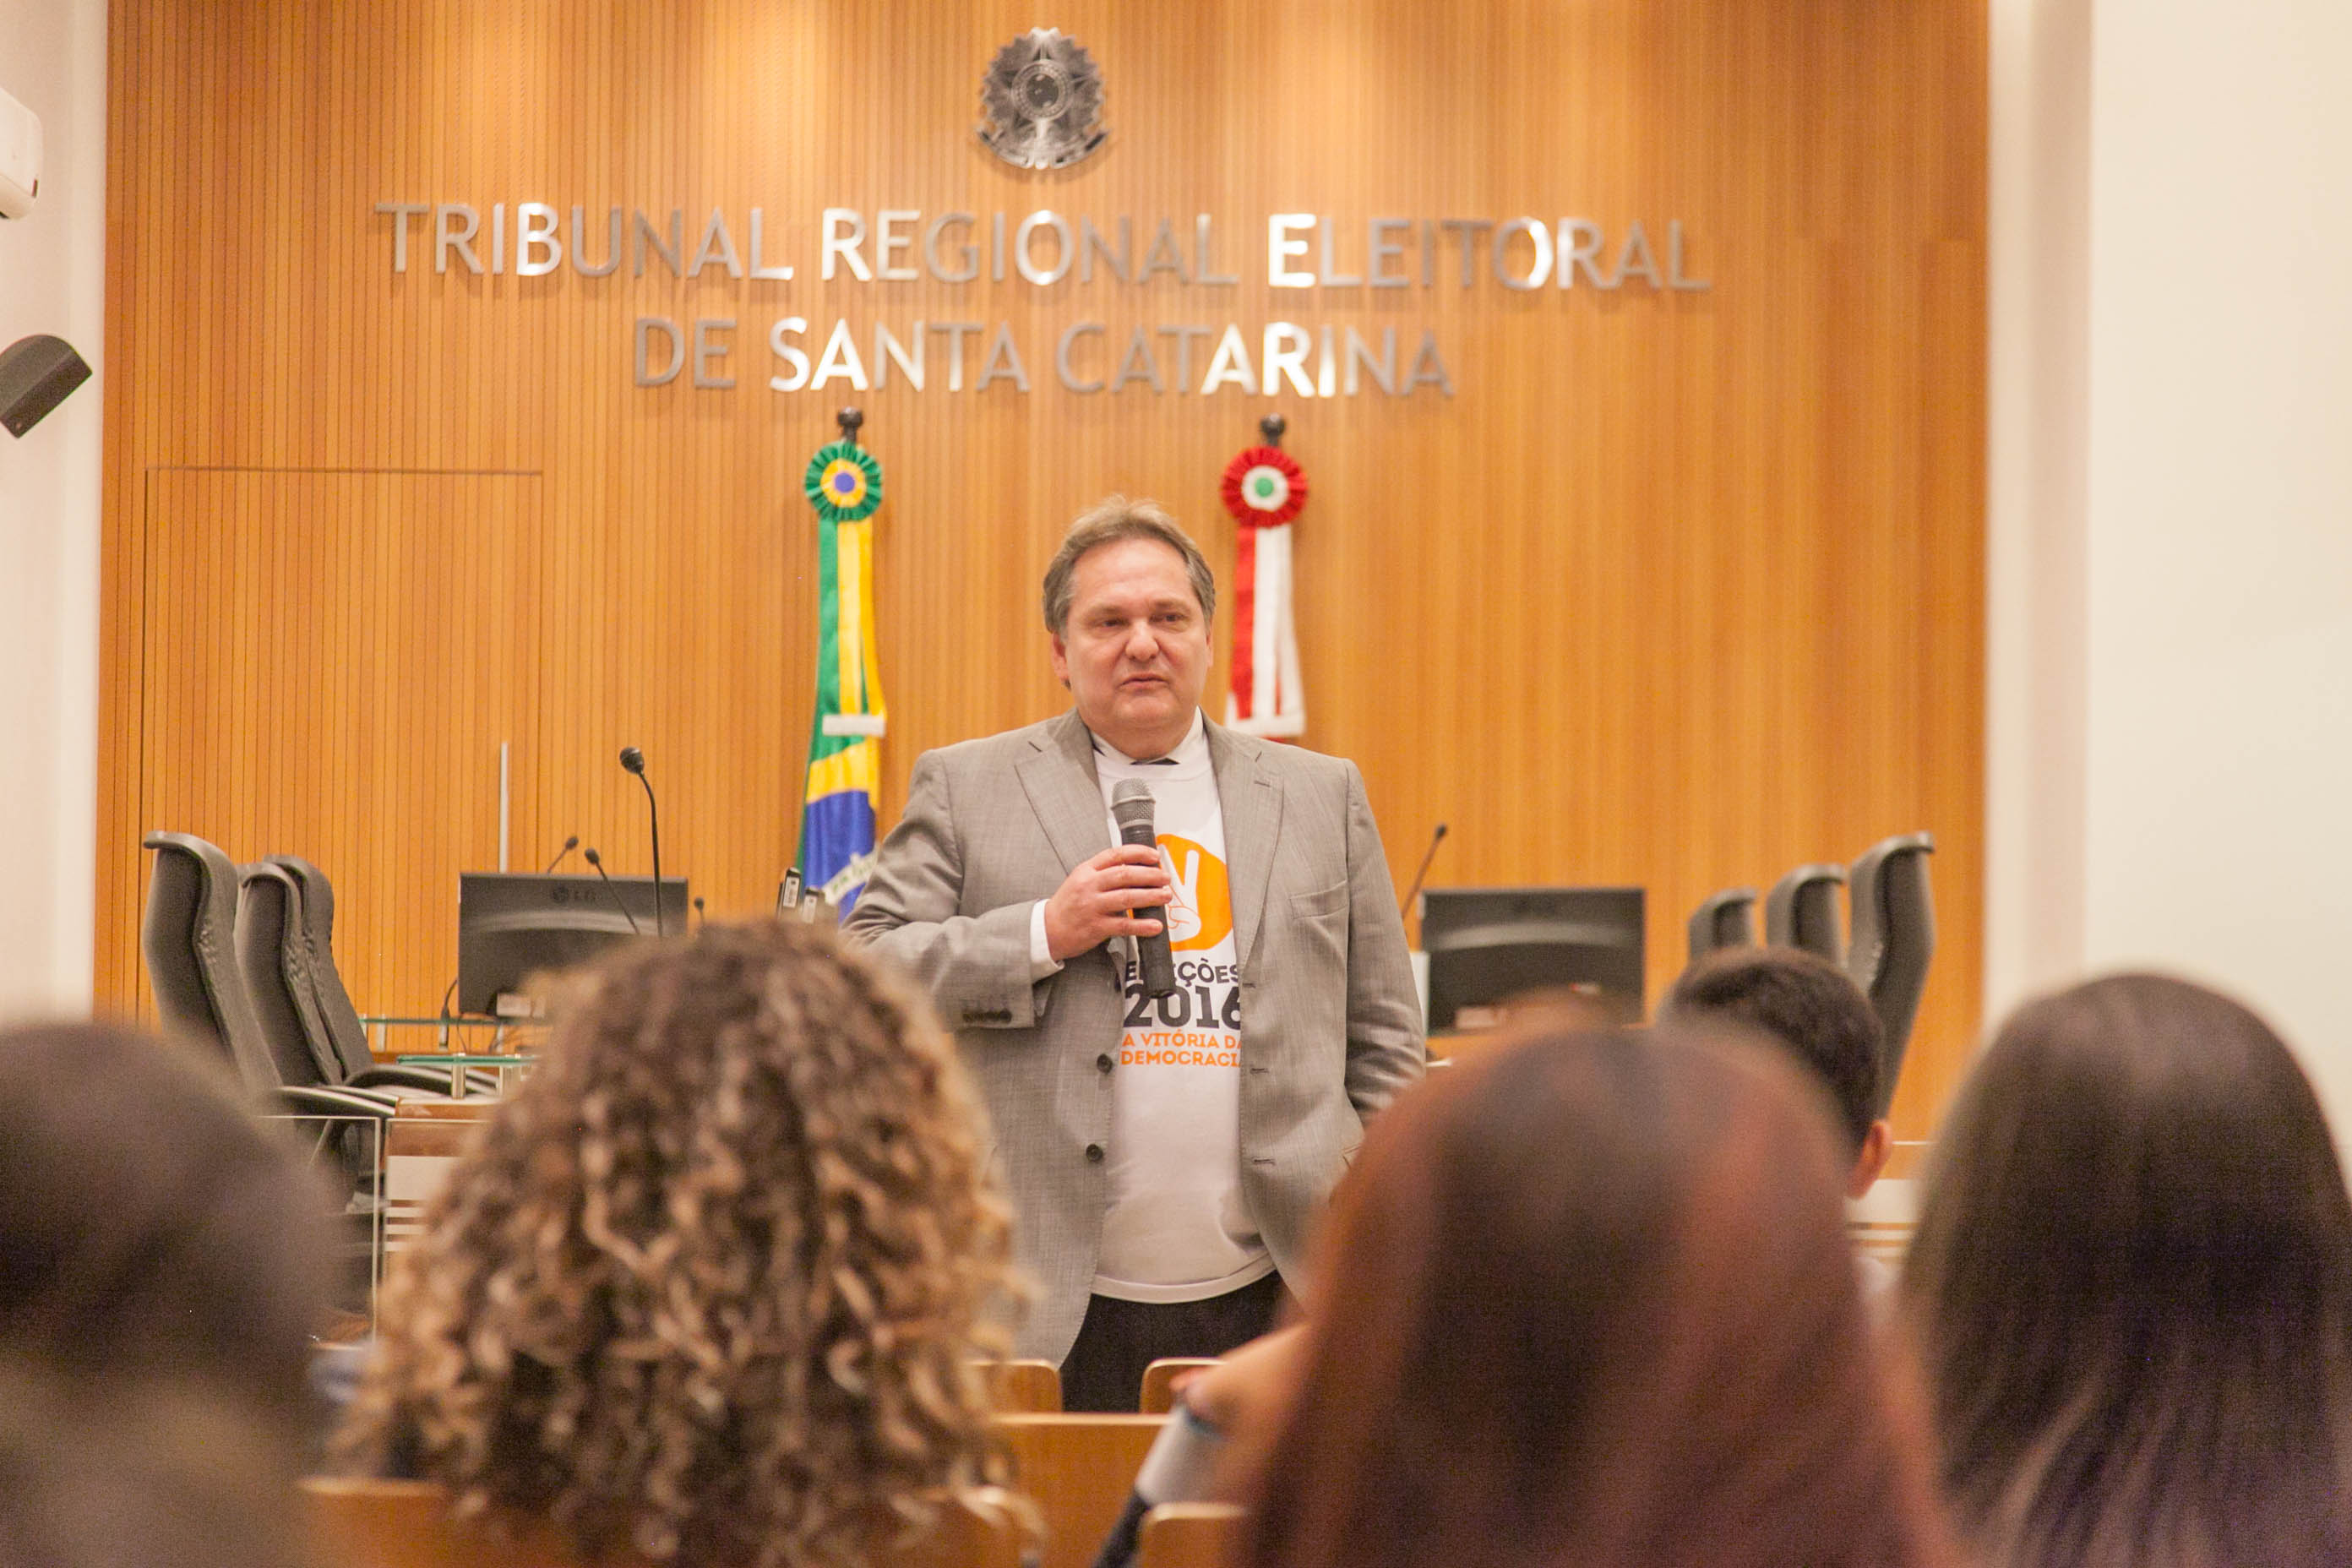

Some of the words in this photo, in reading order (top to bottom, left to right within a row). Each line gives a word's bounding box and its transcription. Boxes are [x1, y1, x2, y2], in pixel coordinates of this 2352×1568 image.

[374, 202, 794, 281] TRIBUNAL
[821, 208, 1239, 286] REGIONAL
[1267, 213, 1712, 291] ELEITORAL
[635, 317, 738, 389] DE
[769, 318, 1032, 393] SANTA
[1056, 322, 1455, 398] CATARINA
[1124, 957, 1239, 987] EÇÕES
[1123, 983, 1241, 1030] 2016
[1121, 1033, 1135, 1048] A
[1140, 1028, 1220, 1048] VITÓRIA
[1120, 1050, 1242, 1068] DEMOCRACI
